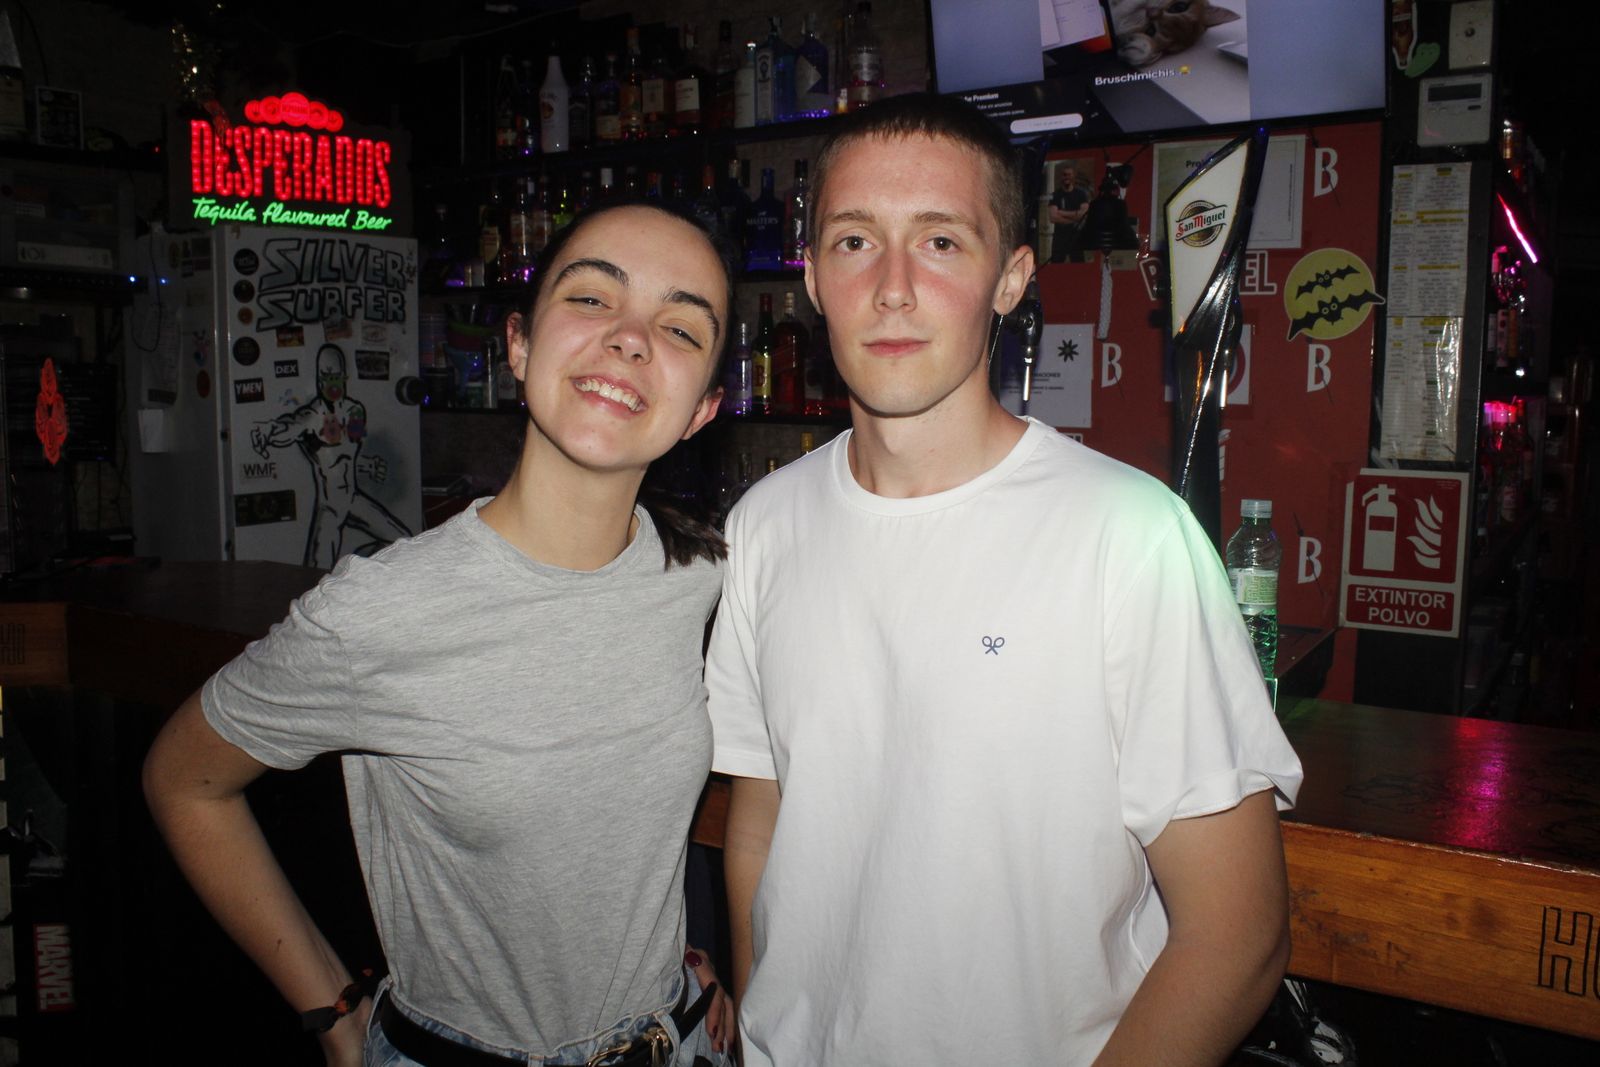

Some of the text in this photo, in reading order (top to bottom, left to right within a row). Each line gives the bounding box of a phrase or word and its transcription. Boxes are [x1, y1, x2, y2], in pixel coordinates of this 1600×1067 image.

[1094, 68, 1175, 86] Bruschimichis
[190, 119, 392, 208] DESPERADOS
[1314, 147, 1339, 198] B
[192, 197, 392, 231] Tequila flavoured Beer
[1193, 209, 1226, 228] Miguel
[258, 238, 406, 292] SILVER
[256, 287, 406, 332] SURFER
[1101, 343, 1122, 388] B
[1307, 343, 1332, 392] B
[1297, 536, 1322, 585] B
[1355, 587, 1446, 609] EXTINTOR
[1368, 606, 1430, 627] POLVO
[36, 925, 74, 1010] MARVEL
[1538, 905, 1600, 1000] H
